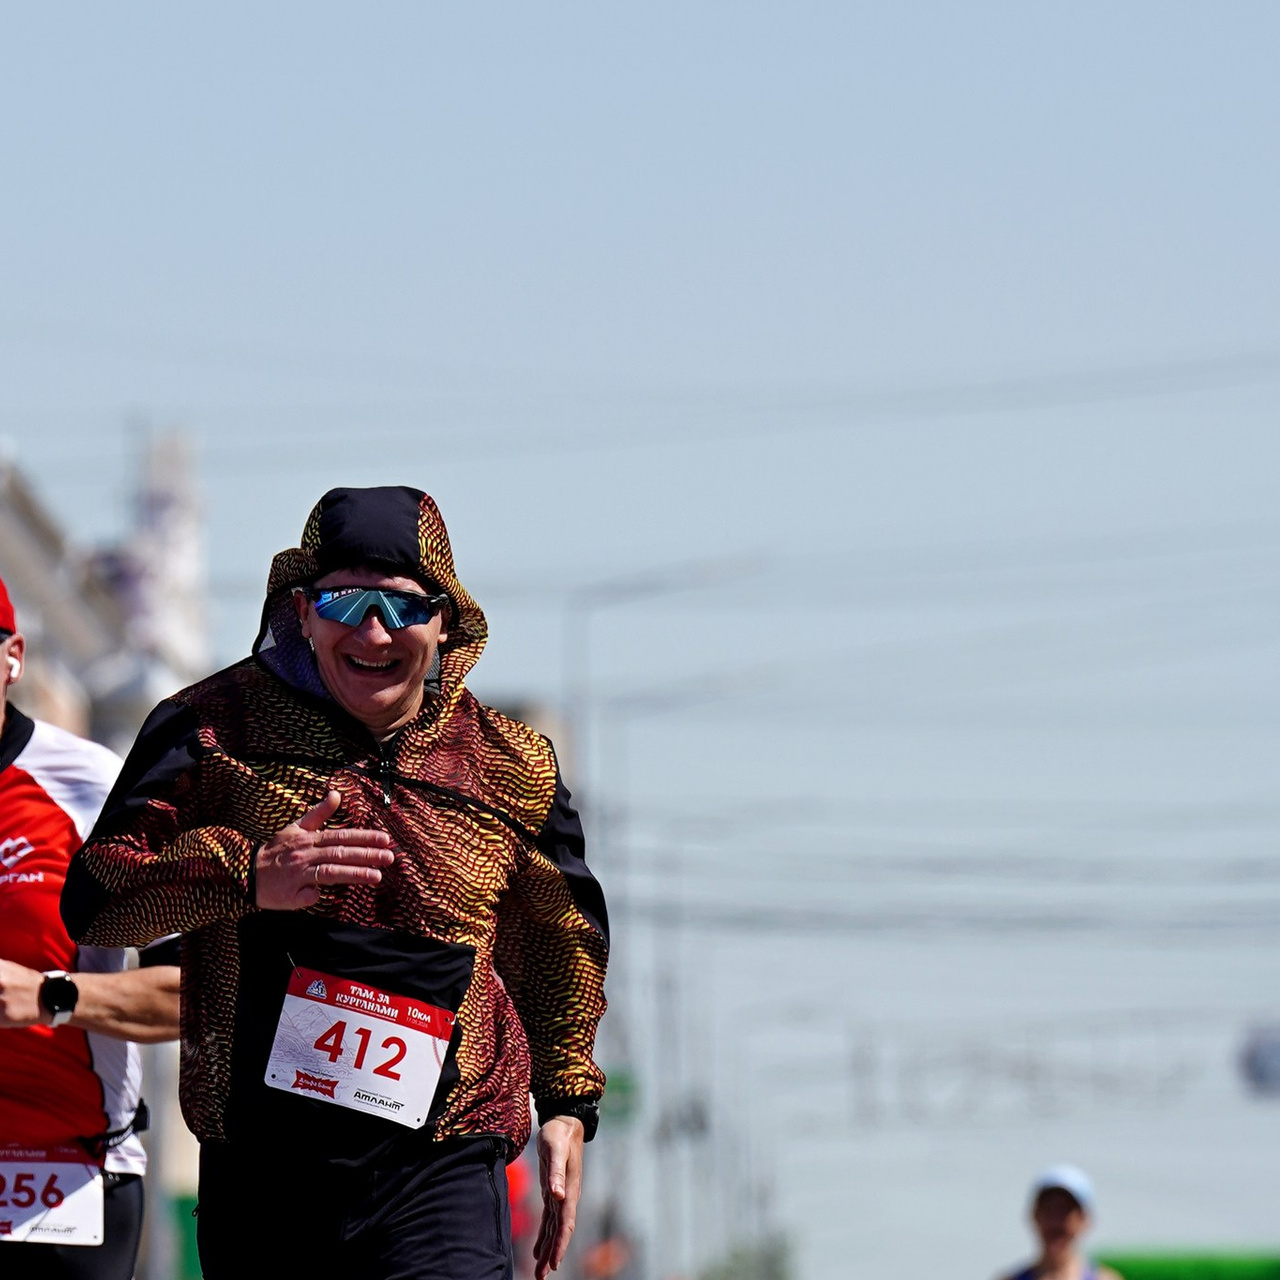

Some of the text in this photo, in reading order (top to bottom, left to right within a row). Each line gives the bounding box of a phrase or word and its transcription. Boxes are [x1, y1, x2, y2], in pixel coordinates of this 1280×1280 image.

[335, 993, 399, 1019] КУРГАНАМИ
[349, 985, 391, 1005] ТАМ, ЗА
[313, 1019, 408, 1082] 412
